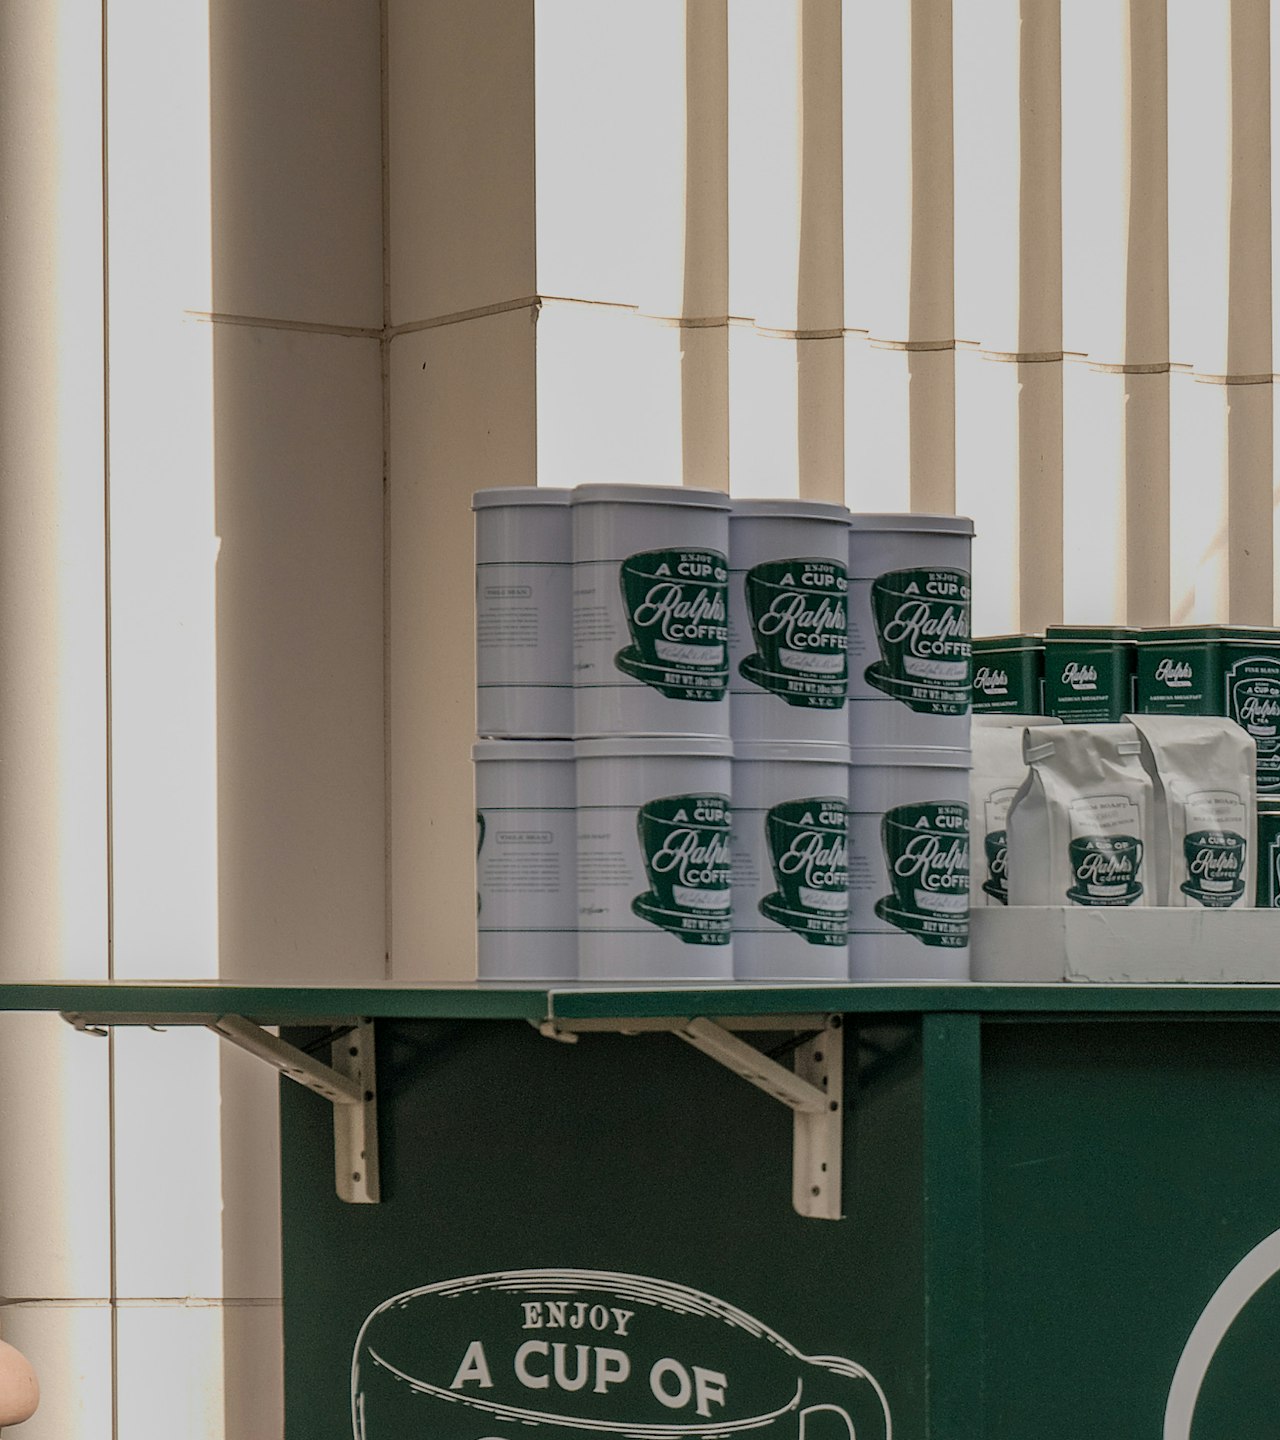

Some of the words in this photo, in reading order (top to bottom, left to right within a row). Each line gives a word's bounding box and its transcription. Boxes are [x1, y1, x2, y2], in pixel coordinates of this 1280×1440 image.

[655, 563, 671, 576] A
[678, 563, 712, 576] CUP
[780, 573, 795, 585] A
[802, 574, 835, 586] CUP
[905, 582, 920, 594] A
[926, 583, 958, 595] CUP
[634, 583, 725, 641] Ralph's
[670, 625, 728, 640] COFFEE
[1062, 662, 1097, 687] Ralph's
[1156, 659, 1192, 685] Ralph's
[1254, 686, 1269, 694] CUP
[1241, 697, 1280, 725] Ralph's
[673, 809, 688, 821] A
[694, 809, 723, 821] CUP
[724, 812, 731, 825] O
[799, 812, 813, 824] A
[819, 812, 843, 825] CUP
[915, 816, 930, 828] A
[935, 816, 963, 829] CUP
[652, 829, 731, 886] Ralph
[1114, 841, 1128, 849] OF
[894, 835, 968, 890] Ralph
[1077, 853, 1132, 885] Ralph's
[1191, 849, 1237, 880] Ralph's
[520, 1301, 635, 1338] ENJOY
[449, 1340, 493, 1391] A
[514, 1340, 631, 1393] CUP
[649, 1357, 728, 1417] OF
